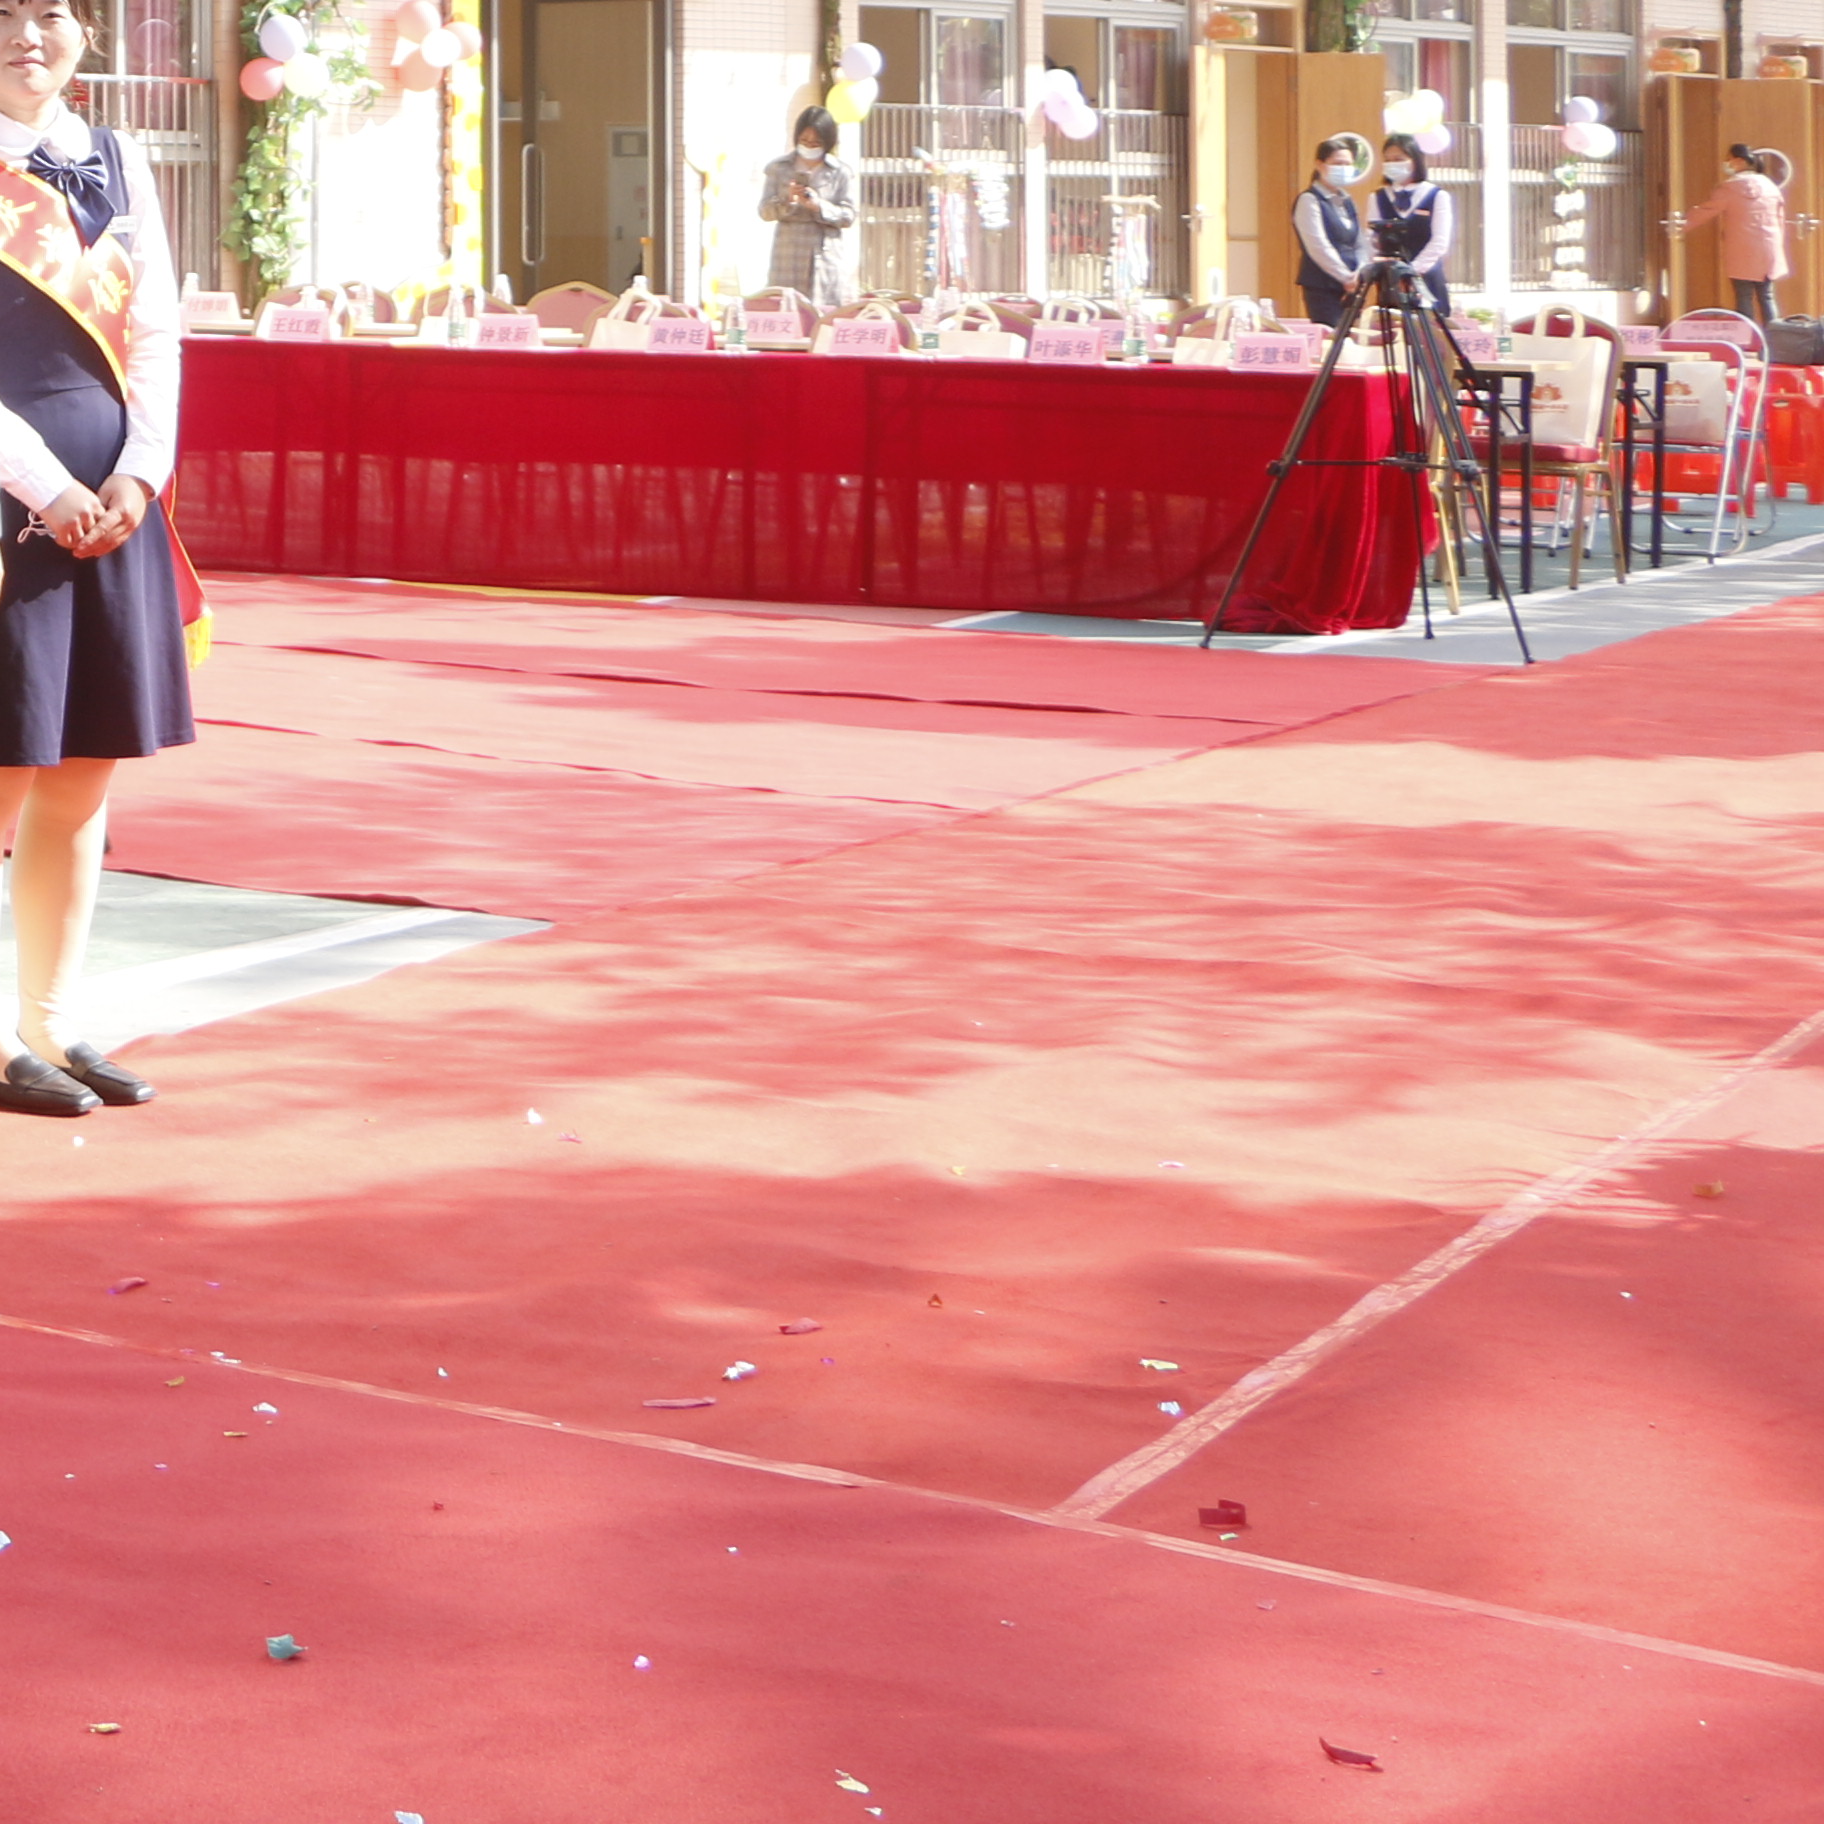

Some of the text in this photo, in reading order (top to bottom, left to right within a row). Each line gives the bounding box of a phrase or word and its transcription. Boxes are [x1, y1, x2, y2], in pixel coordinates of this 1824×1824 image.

[273, 317, 322, 334] 王红霞
[834, 328, 888, 345] 任学明
